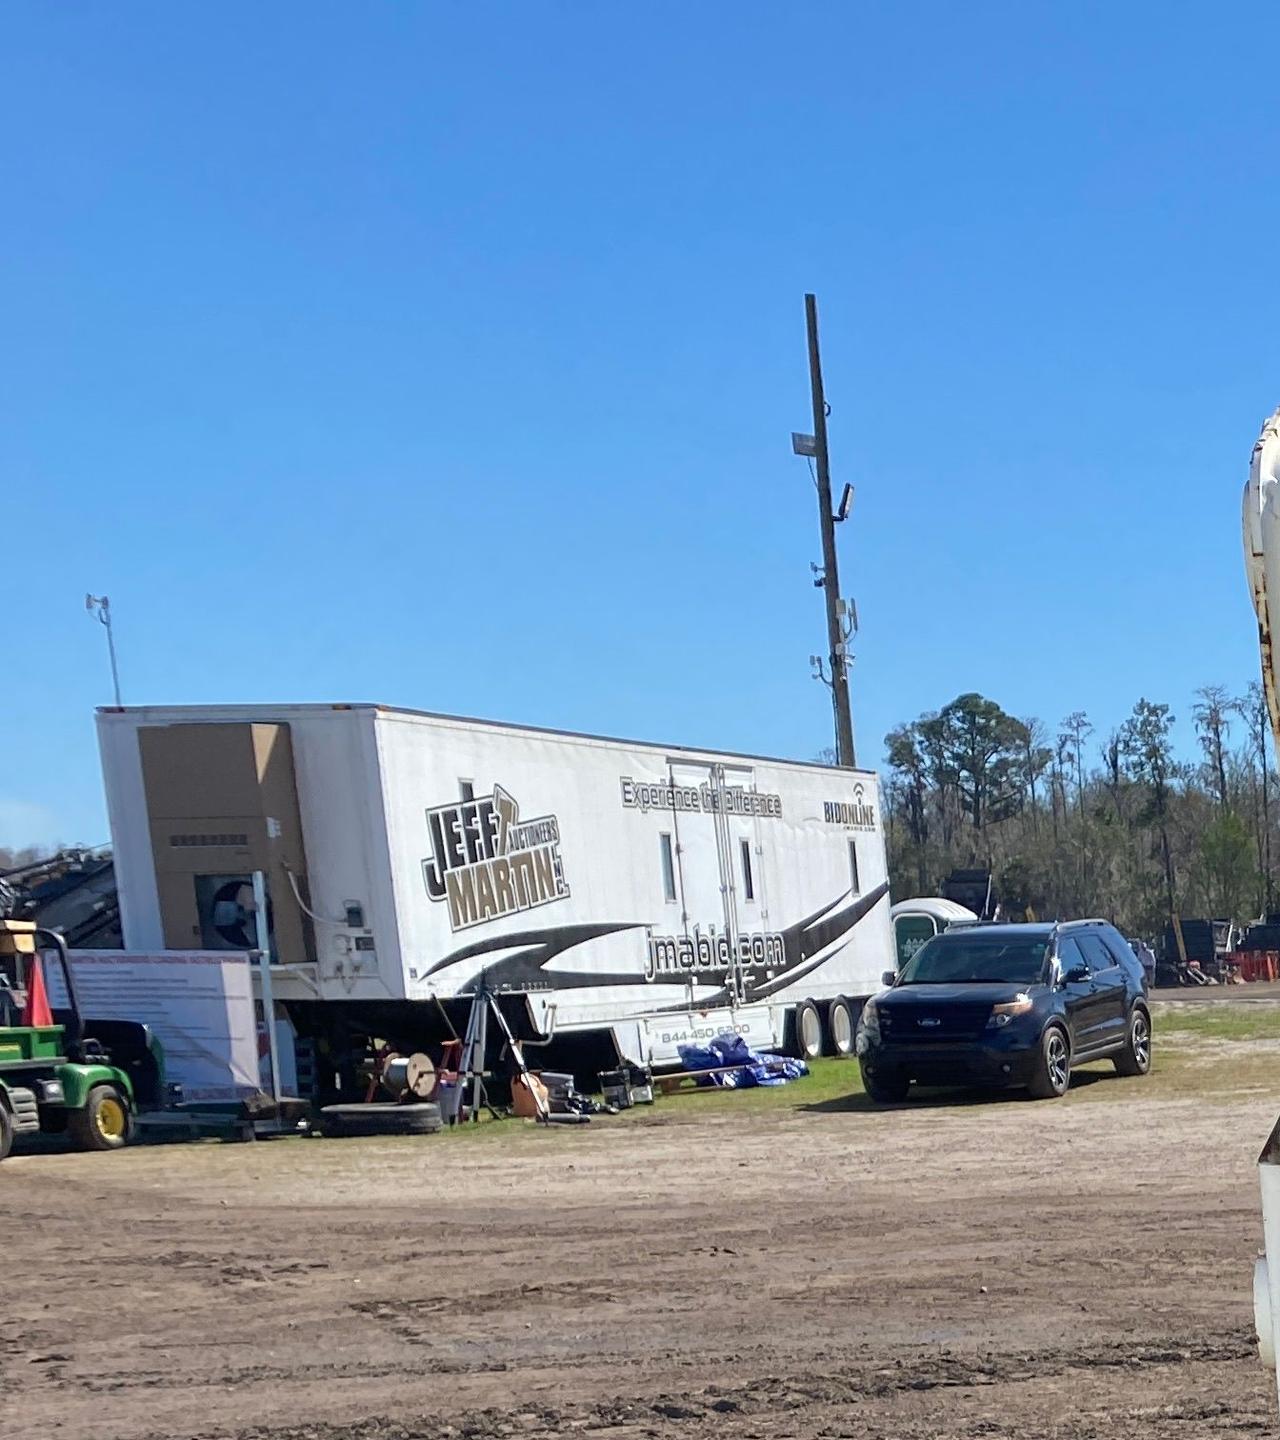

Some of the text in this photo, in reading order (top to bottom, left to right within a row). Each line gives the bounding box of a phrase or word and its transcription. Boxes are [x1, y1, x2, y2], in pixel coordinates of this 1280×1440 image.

[621, 777, 700, 813] Experience
[823, 801, 875, 826] BIDONLINE
[422, 798, 501, 900] JEFF
[507, 819, 558, 851] AUCTIONEERS
[445, 847, 557, 929] MARTIN
